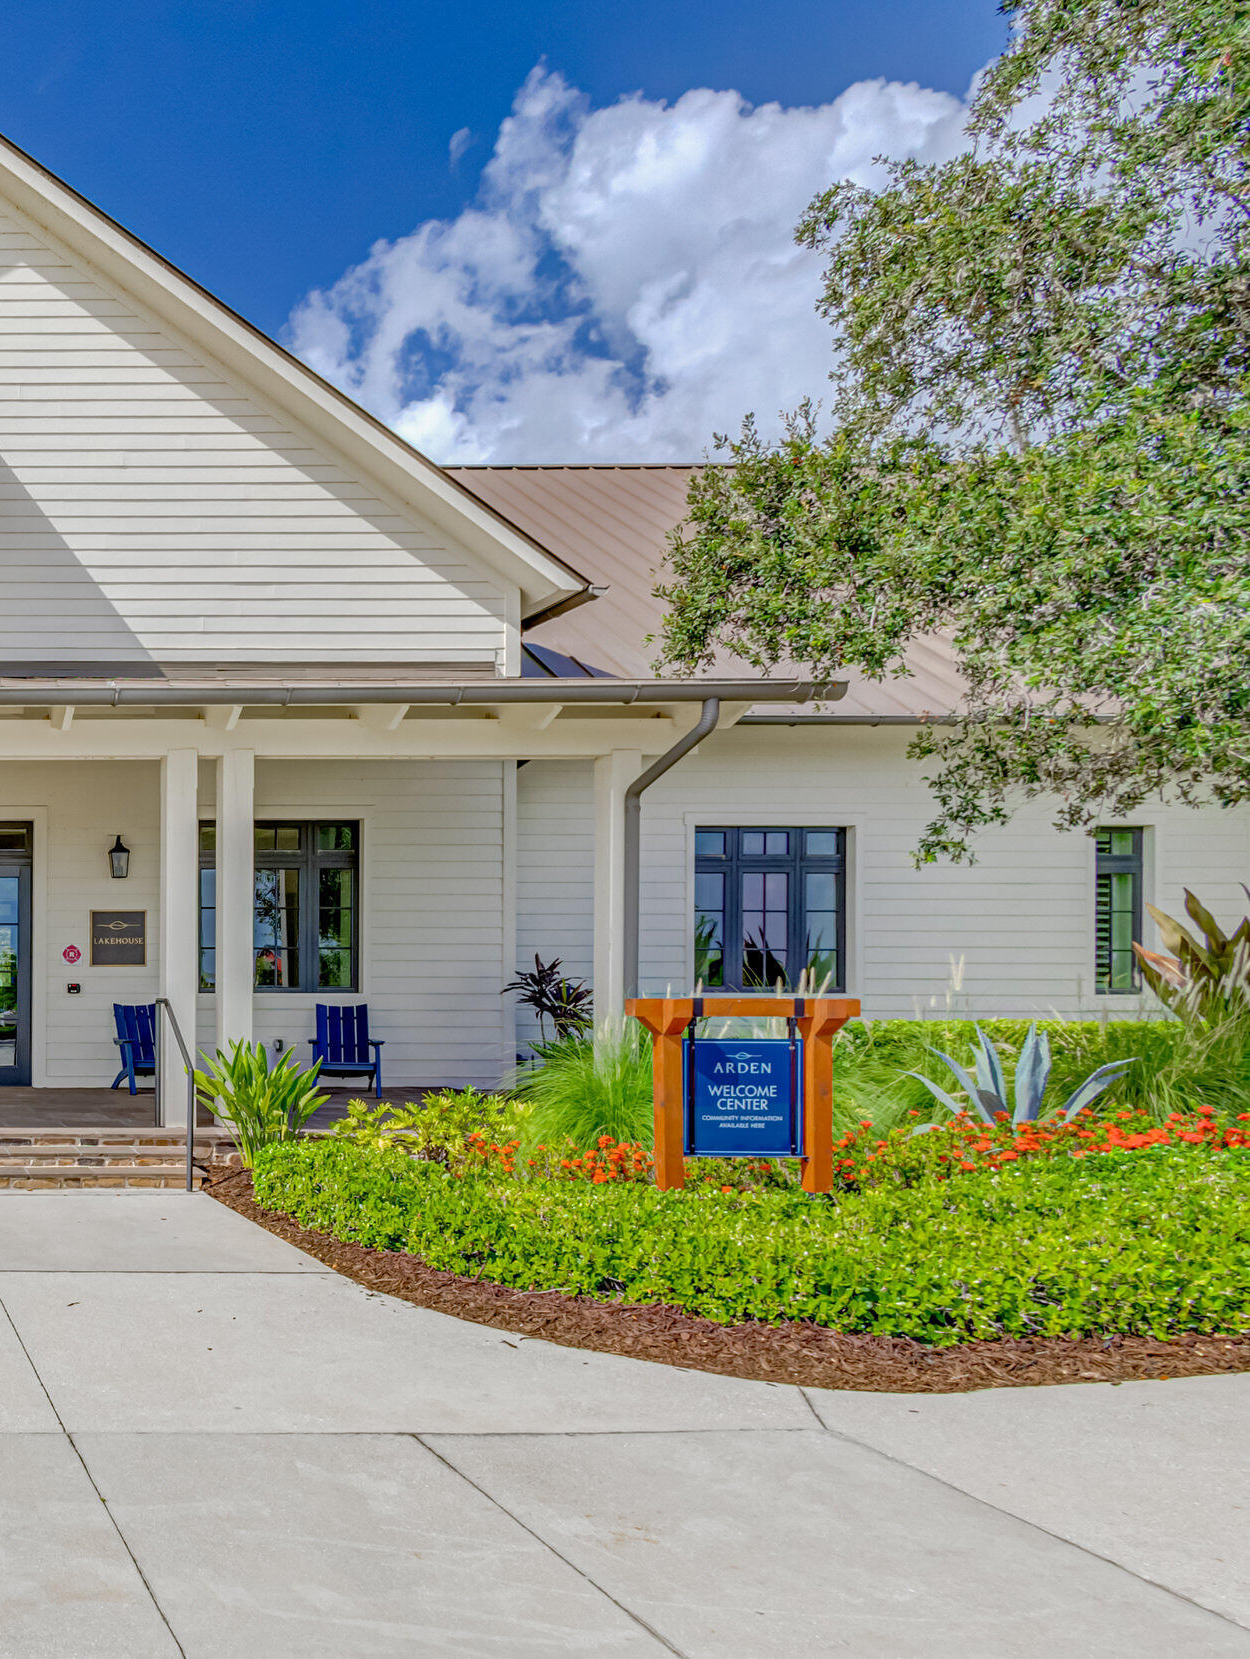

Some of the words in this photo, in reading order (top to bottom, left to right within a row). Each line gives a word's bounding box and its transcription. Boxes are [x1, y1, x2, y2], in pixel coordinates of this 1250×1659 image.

[93, 937, 144, 945] LAKEHOUSE
[713, 1062, 772, 1074] ARDEN
[707, 1085, 778, 1097] WELCOME
[717, 1098, 768, 1110] CENTER
